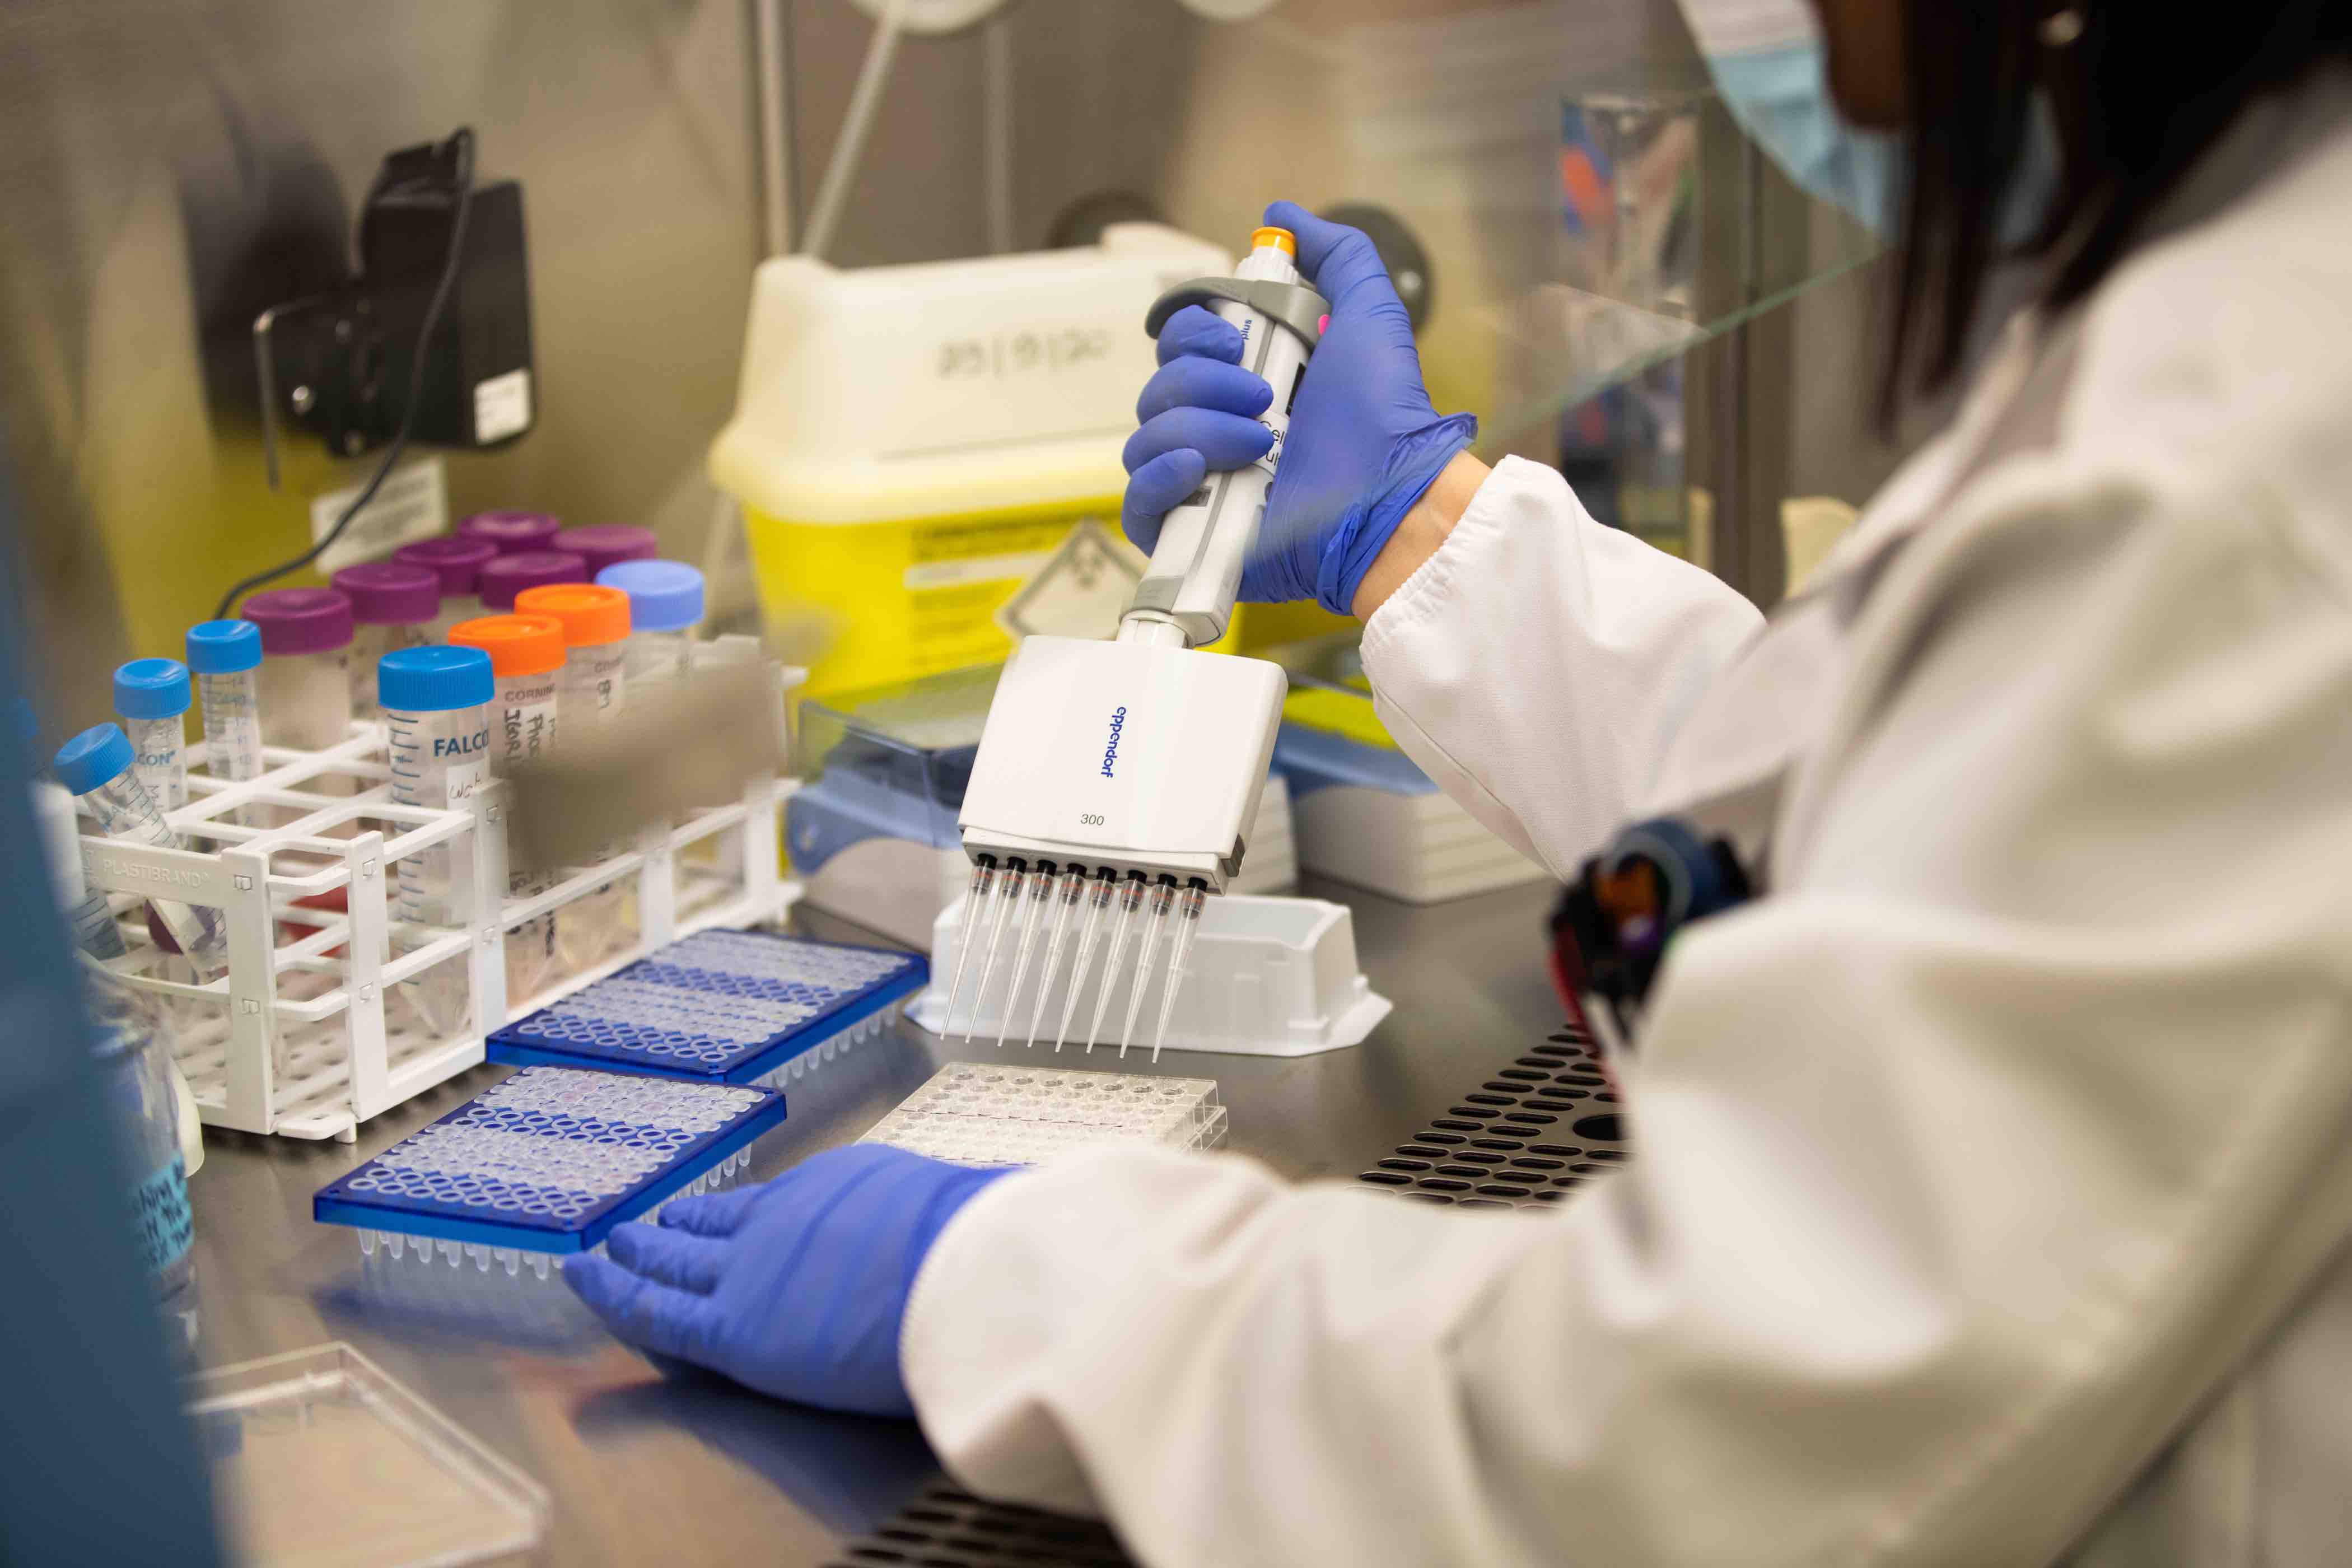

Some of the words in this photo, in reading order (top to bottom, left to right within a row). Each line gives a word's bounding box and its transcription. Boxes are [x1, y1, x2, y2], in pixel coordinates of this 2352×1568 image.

[1241, 319, 1252, 340] plus
[1101, 706, 1127, 778] eppendorf
[1080, 813, 1104, 826] 300
